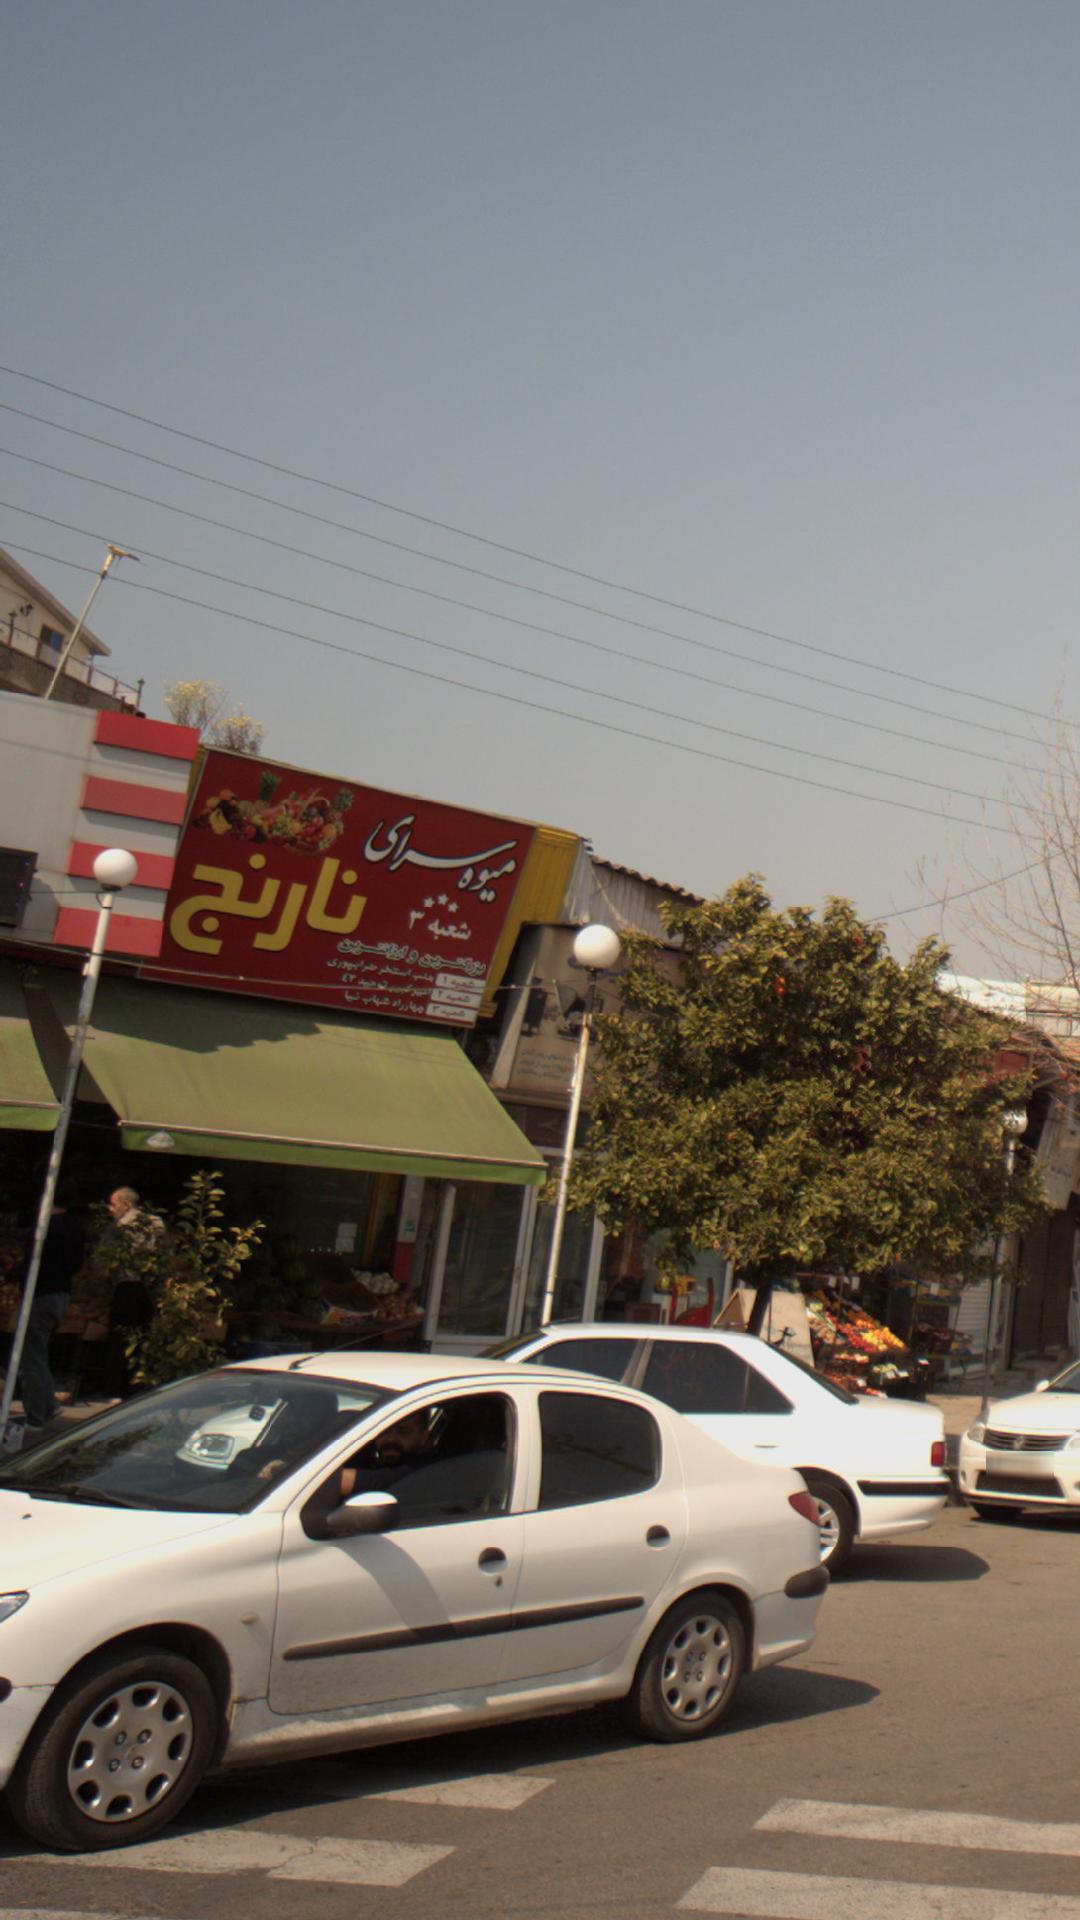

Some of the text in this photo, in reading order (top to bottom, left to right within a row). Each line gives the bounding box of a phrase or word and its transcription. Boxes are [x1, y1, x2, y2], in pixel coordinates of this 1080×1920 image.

[363, 814, 518, 902] میوه سرای
[169, 852, 368, 955] نارنج
[409, 910, 472, 940] شعبه ۳
